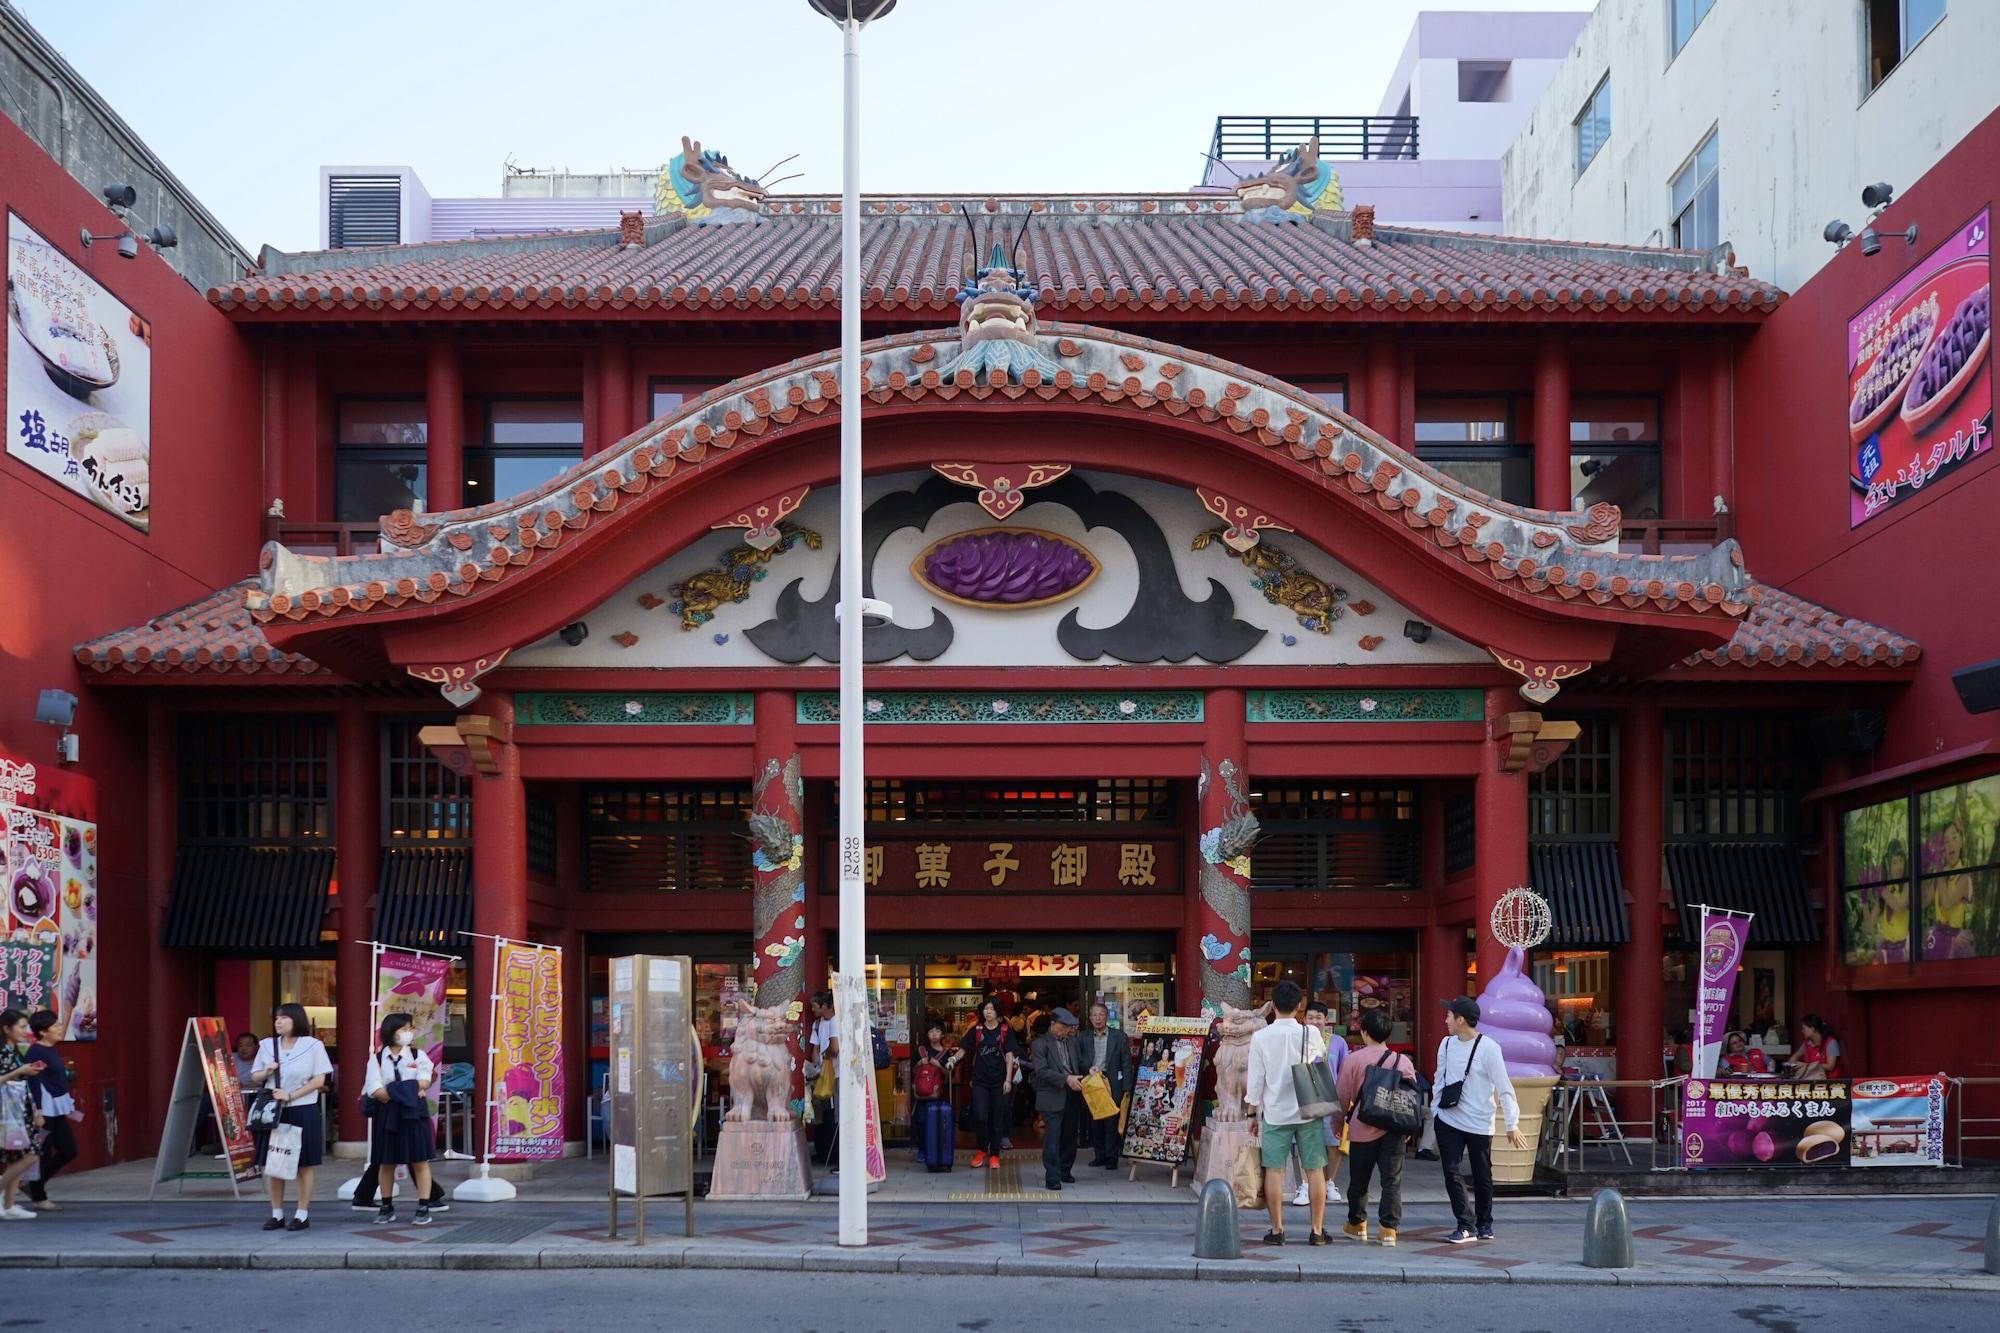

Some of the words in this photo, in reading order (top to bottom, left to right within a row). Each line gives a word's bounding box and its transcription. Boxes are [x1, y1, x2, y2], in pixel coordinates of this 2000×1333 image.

[1861, 442, 1880, 480] 元祖
[1864, 419, 1986, 517] 紅いもタルト
[844, 837, 860, 850] 39
[843, 850, 860, 863] R3
[843, 864, 860, 877] P4
[10, 948, 28, 995] ケーキ
[1686, 1100, 1706, 1108] 2017
[1715, 1101, 1836, 1118] 紅いもみるくまん
